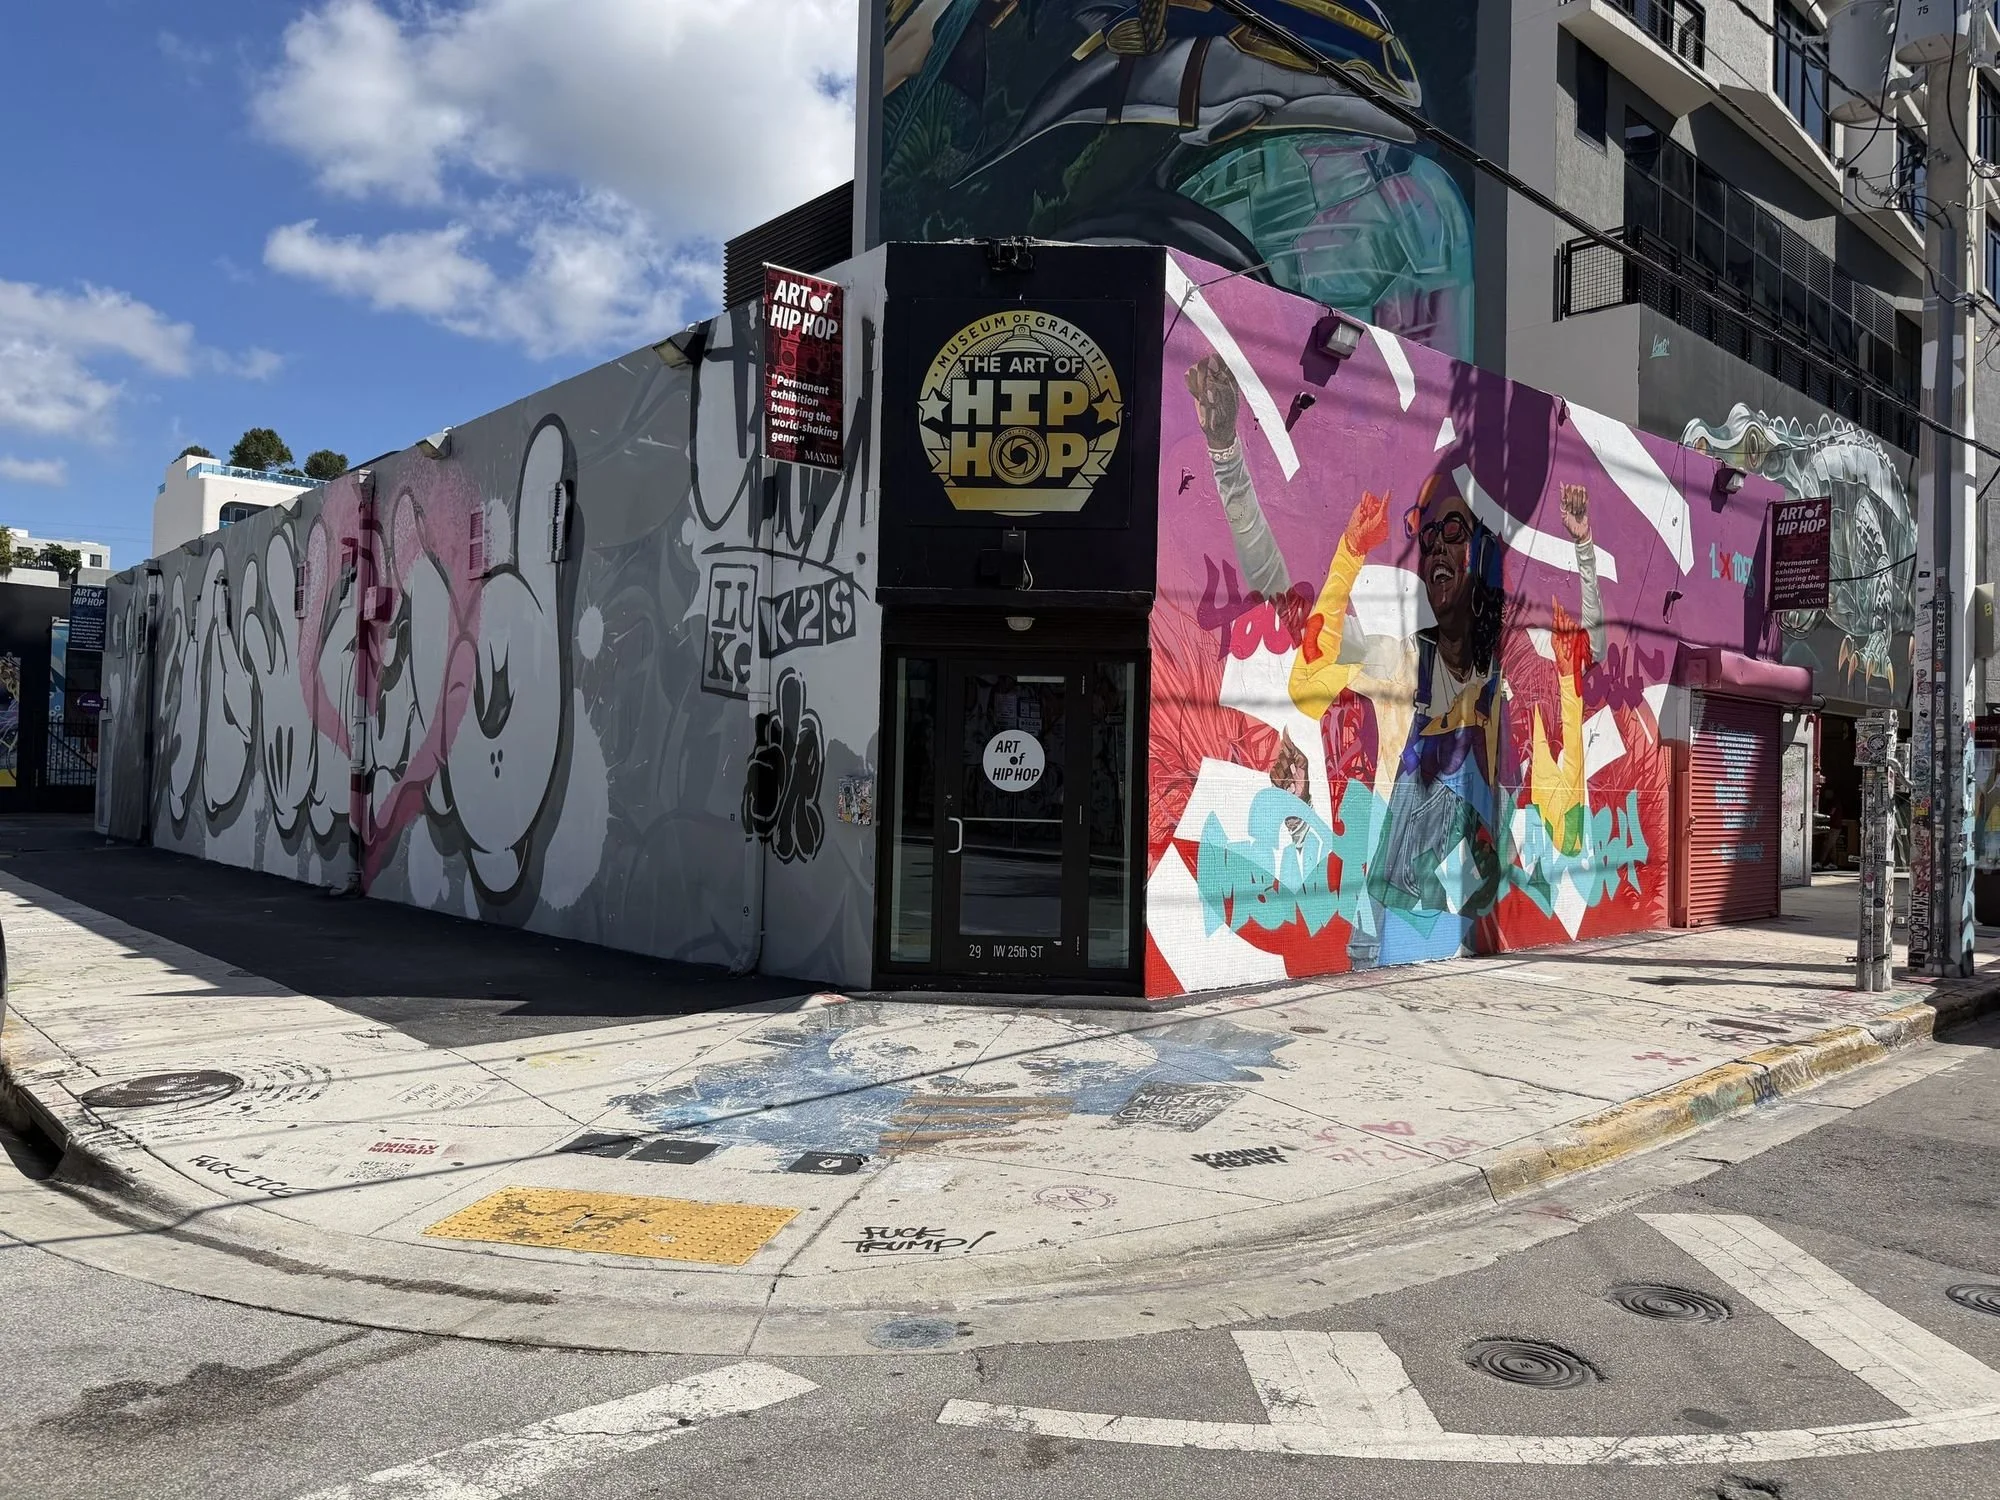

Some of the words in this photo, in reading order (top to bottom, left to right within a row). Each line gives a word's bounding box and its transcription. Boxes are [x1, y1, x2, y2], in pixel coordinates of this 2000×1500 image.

[1917, 5, 1929, 16] 75
[773, 280, 812, 308] ART
[769, 305, 801, 331] HIP
[802, 315, 839, 341] HOP
[938, 316, 1006, 368] MUSEUM
[1012, 314, 1031, 323] OF
[1035, 316, 1107, 372] GRAFFITI
[961, 356, 1001, 373] THE
[1009, 357, 1049, 373] ART
[1054, 357, 1084, 373] OF
[772, 373, 830, 396] "Permanent
[771, 390, 819, 407] exhibition
[951, 379, 1090, 426] HIP
[771, 402, 814, 422] honoring
[816, 412, 832, 424] the
[771, 419, 839, 440] world-shaking
[771, 431, 805, 444] genre"
[804, 450, 838, 465] MAXIM
[950, 427, 1090, 485] HOP
[1778, 506, 1806, 521] ART
[1776, 521, 1798, 536] HIP
[1799, 519, 1827, 533] HOP
[1775, 567, 1811, 575] exhibition
[1775, 575, 1807, 584] honoring
[1775, 582, 1826, 591] world-shaking
[74, 588, 92, 597] ART
[72, 597, 87, 606] HIP
[87, 598, 105, 607] HOP
[995, 741, 1021, 753] ART
[1009, 752, 1026, 765] of
[993, 768, 1013, 781] HIP
[1014, 768, 1040, 781] HOP
[1008, 945, 1028, 958] 25th
[1030, 945, 1044, 958] ST
[1133, 1092, 1232, 1108] MUSEUM
[367, 1147, 435, 1155] MADRID
[187, 1155, 250, 1179] FUCK
[232, 1175, 318, 1198] ICE
[859, 1226, 946, 1240] FUCK
[840, 1231, 997, 1253] TRUMP!
